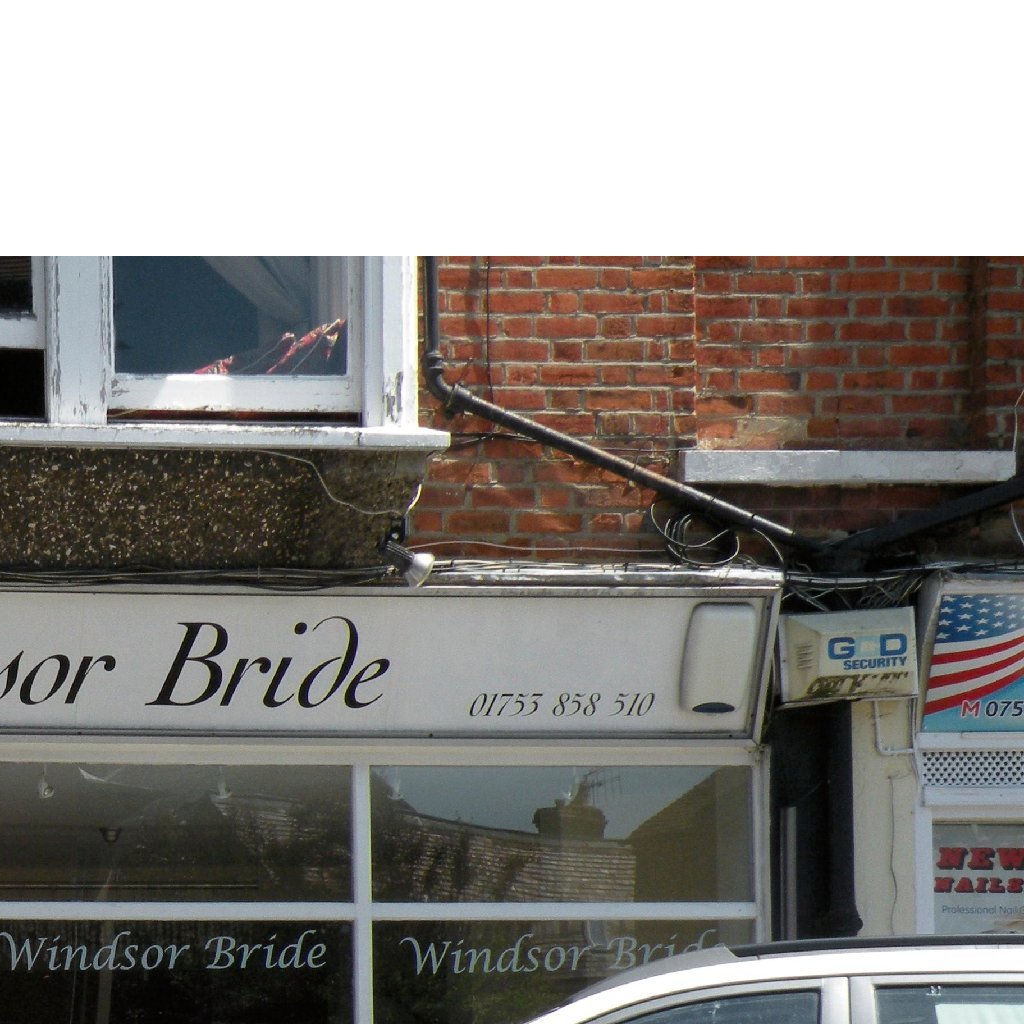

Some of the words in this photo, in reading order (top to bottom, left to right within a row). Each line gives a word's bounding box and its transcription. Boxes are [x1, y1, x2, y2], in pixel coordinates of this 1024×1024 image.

[144, 616, 391, 709] Bride
[843, 656, 908, 671] SECURITY
[469, 692, 544, 717] 01753
[552, 692, 602, 717] 858
[608, 692, 656, 717] 510
[961, 700, 981, 717] M
[985, 700, 1024, 717] 075
[936, 847, 1024, 870] NEW
[934, 877, 1024, 894] NAILS
[941, 904, 997, 915] Professional
[204, 929, 327, 969] Bride
[399, 932, 593, 975] Windsor
[604, 928, 726, 969] Brid
